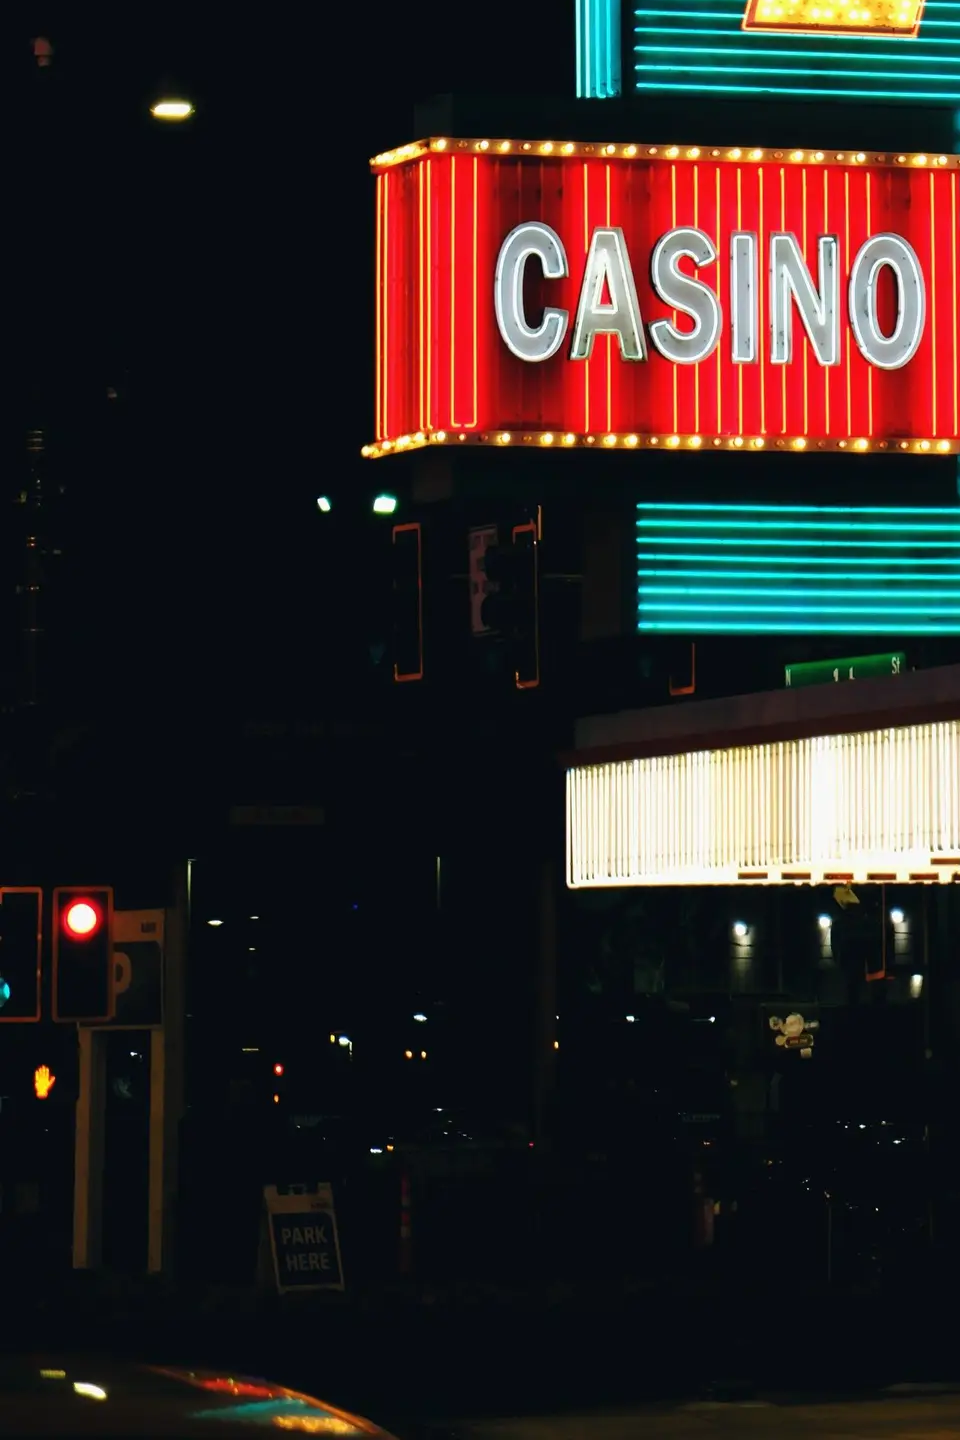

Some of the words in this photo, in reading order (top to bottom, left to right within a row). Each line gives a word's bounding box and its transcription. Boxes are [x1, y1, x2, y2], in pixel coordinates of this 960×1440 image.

[494, 221, 927, 370] CASINO
[281, 1225, 328, 1246] PARK
[285, 1252, 331, 1273] HERE
